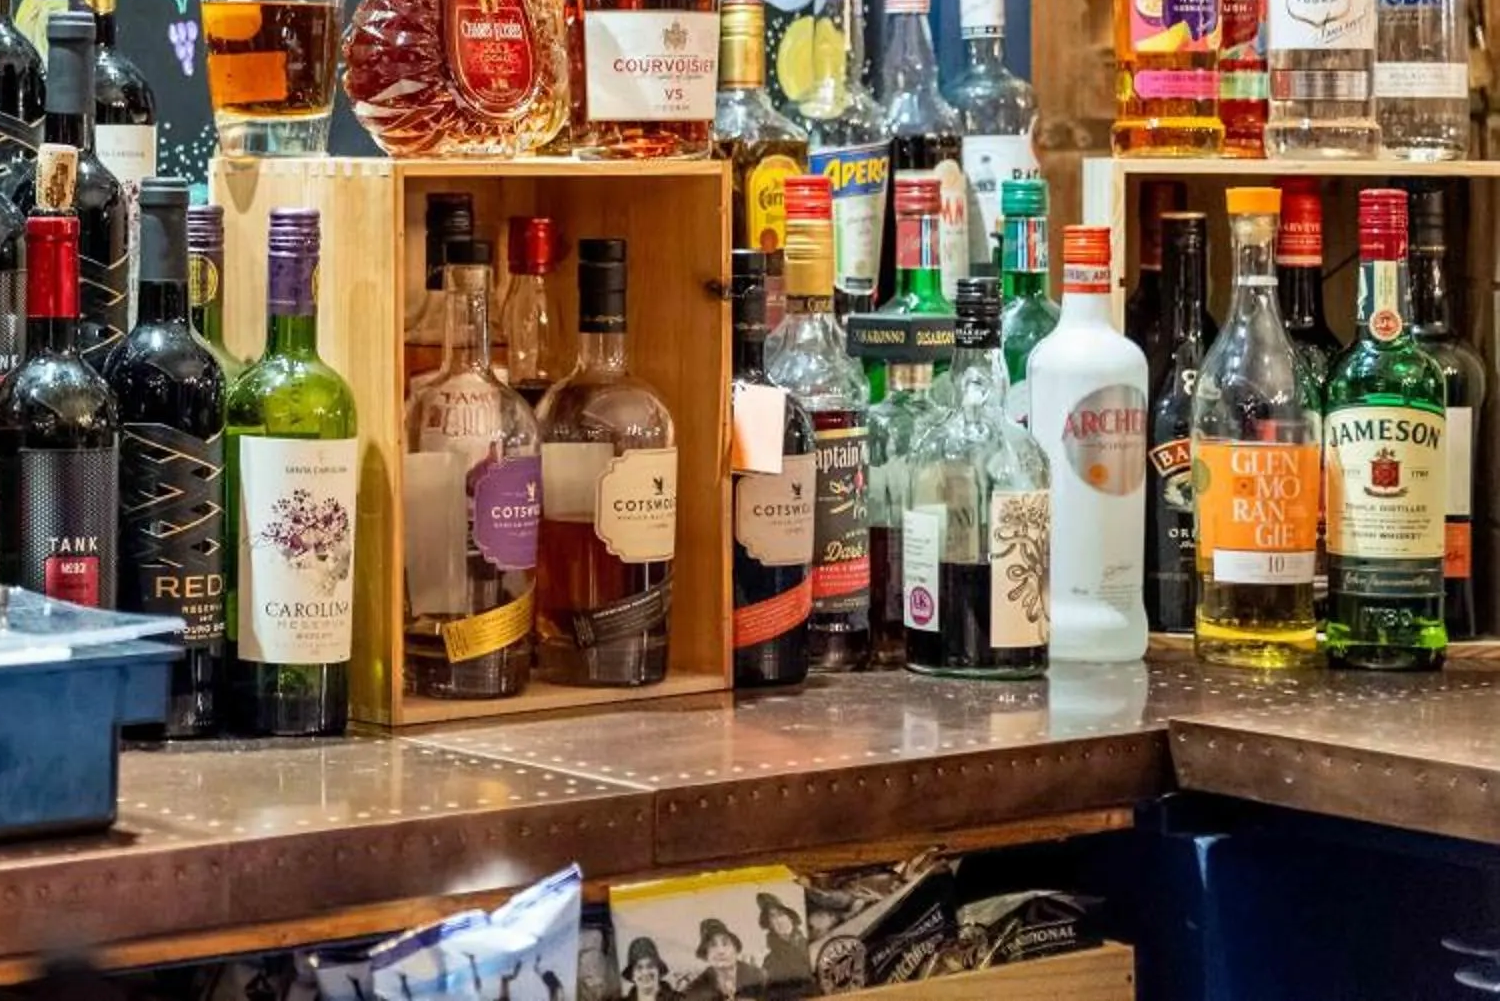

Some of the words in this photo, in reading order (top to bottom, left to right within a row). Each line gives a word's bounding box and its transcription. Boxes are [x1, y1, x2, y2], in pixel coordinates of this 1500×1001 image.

[664, 88, 684, 100] VS
[1330, 418, 1441, 449] JAMESON
[814, 440, 860, 474] aptain
[1231, 449, 1300, 475] GLEN
[1256, 475, 1301, 499] MO
[1231, 498, 1286, 523] RAN
[48, 536, 98, 552] TANK
[1255, 523, 1295, 548] GIE
[1268, 555, 1285, 573] 10
